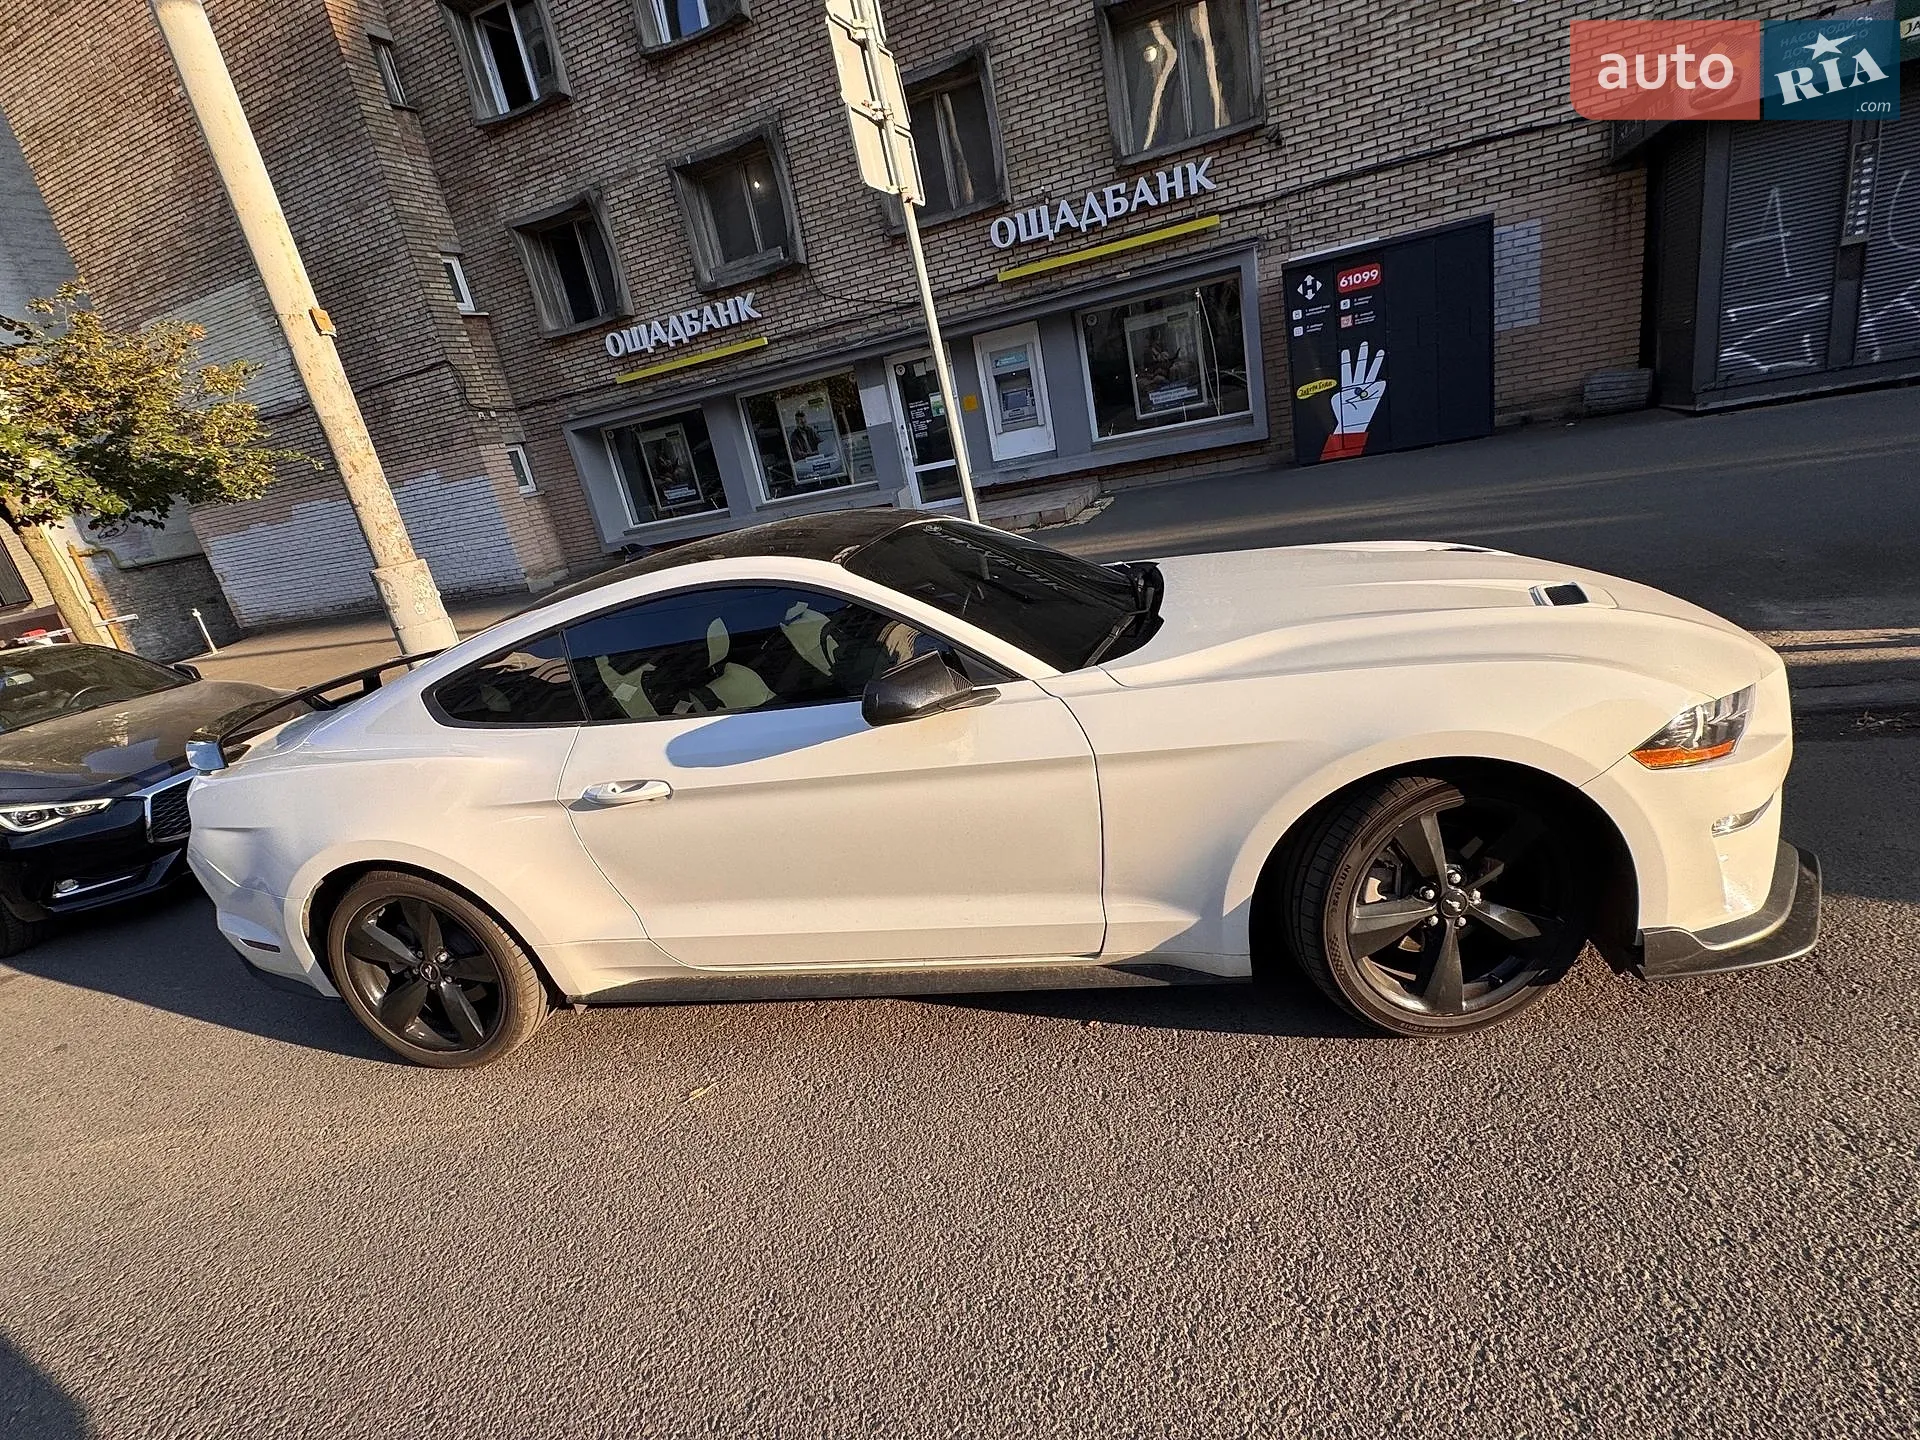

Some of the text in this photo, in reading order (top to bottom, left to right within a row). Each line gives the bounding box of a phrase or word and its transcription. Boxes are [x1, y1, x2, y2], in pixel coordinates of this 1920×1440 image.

[989, 156, 1217, 249] ОЩАДБАНК
[1340, 269, 1379, 287] 61099
[605, 292, 763, 357] ОЩАДБАНК
